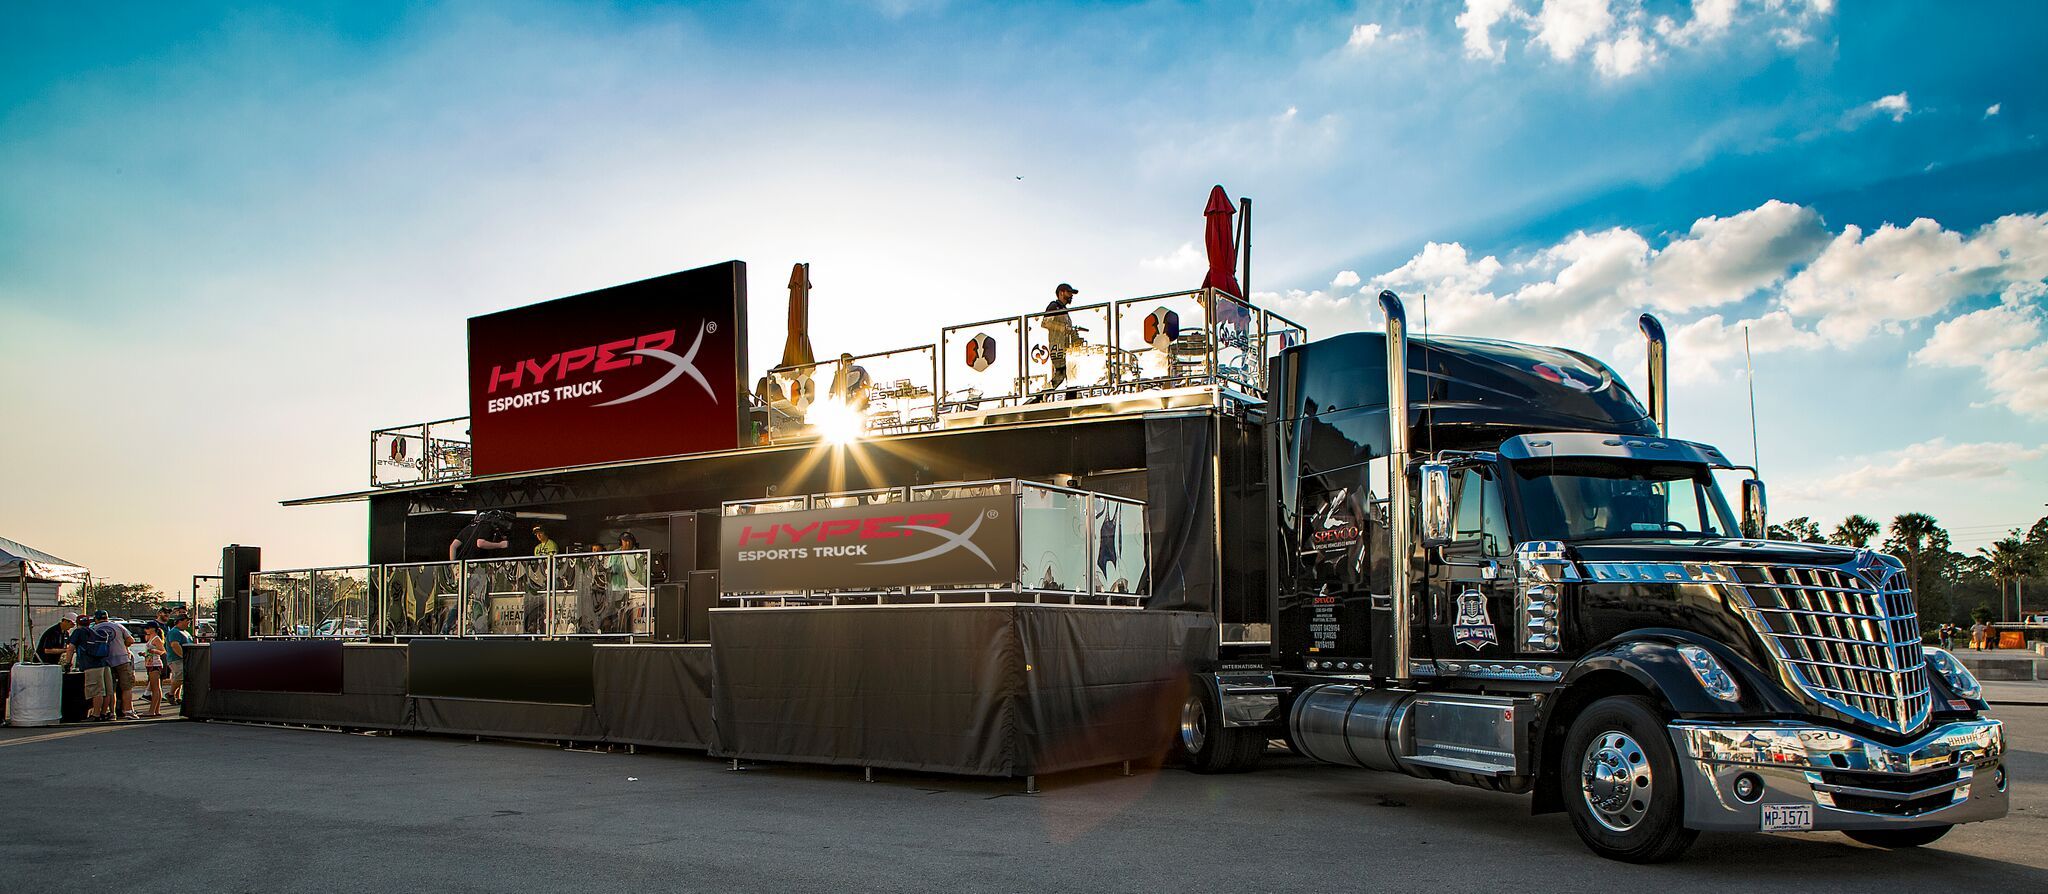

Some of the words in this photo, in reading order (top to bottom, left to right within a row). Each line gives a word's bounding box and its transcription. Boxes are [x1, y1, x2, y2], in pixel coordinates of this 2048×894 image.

[871, 378, 911, 391] ALLIED
[488, 389, 550, 413] ESPORTS
[554, 380, 602, 400] TRUCK
[871, 385, 928, 401] ESPORTS
[1315, 526, 1358, 542] SPEVCO
[738, 548, 808, 562] ESPORTS
[813, 544, 868, 557] TRUCK
[503, 611, 524, 620] HEAT
[1764, 810, 1810, 825] MP-1571
